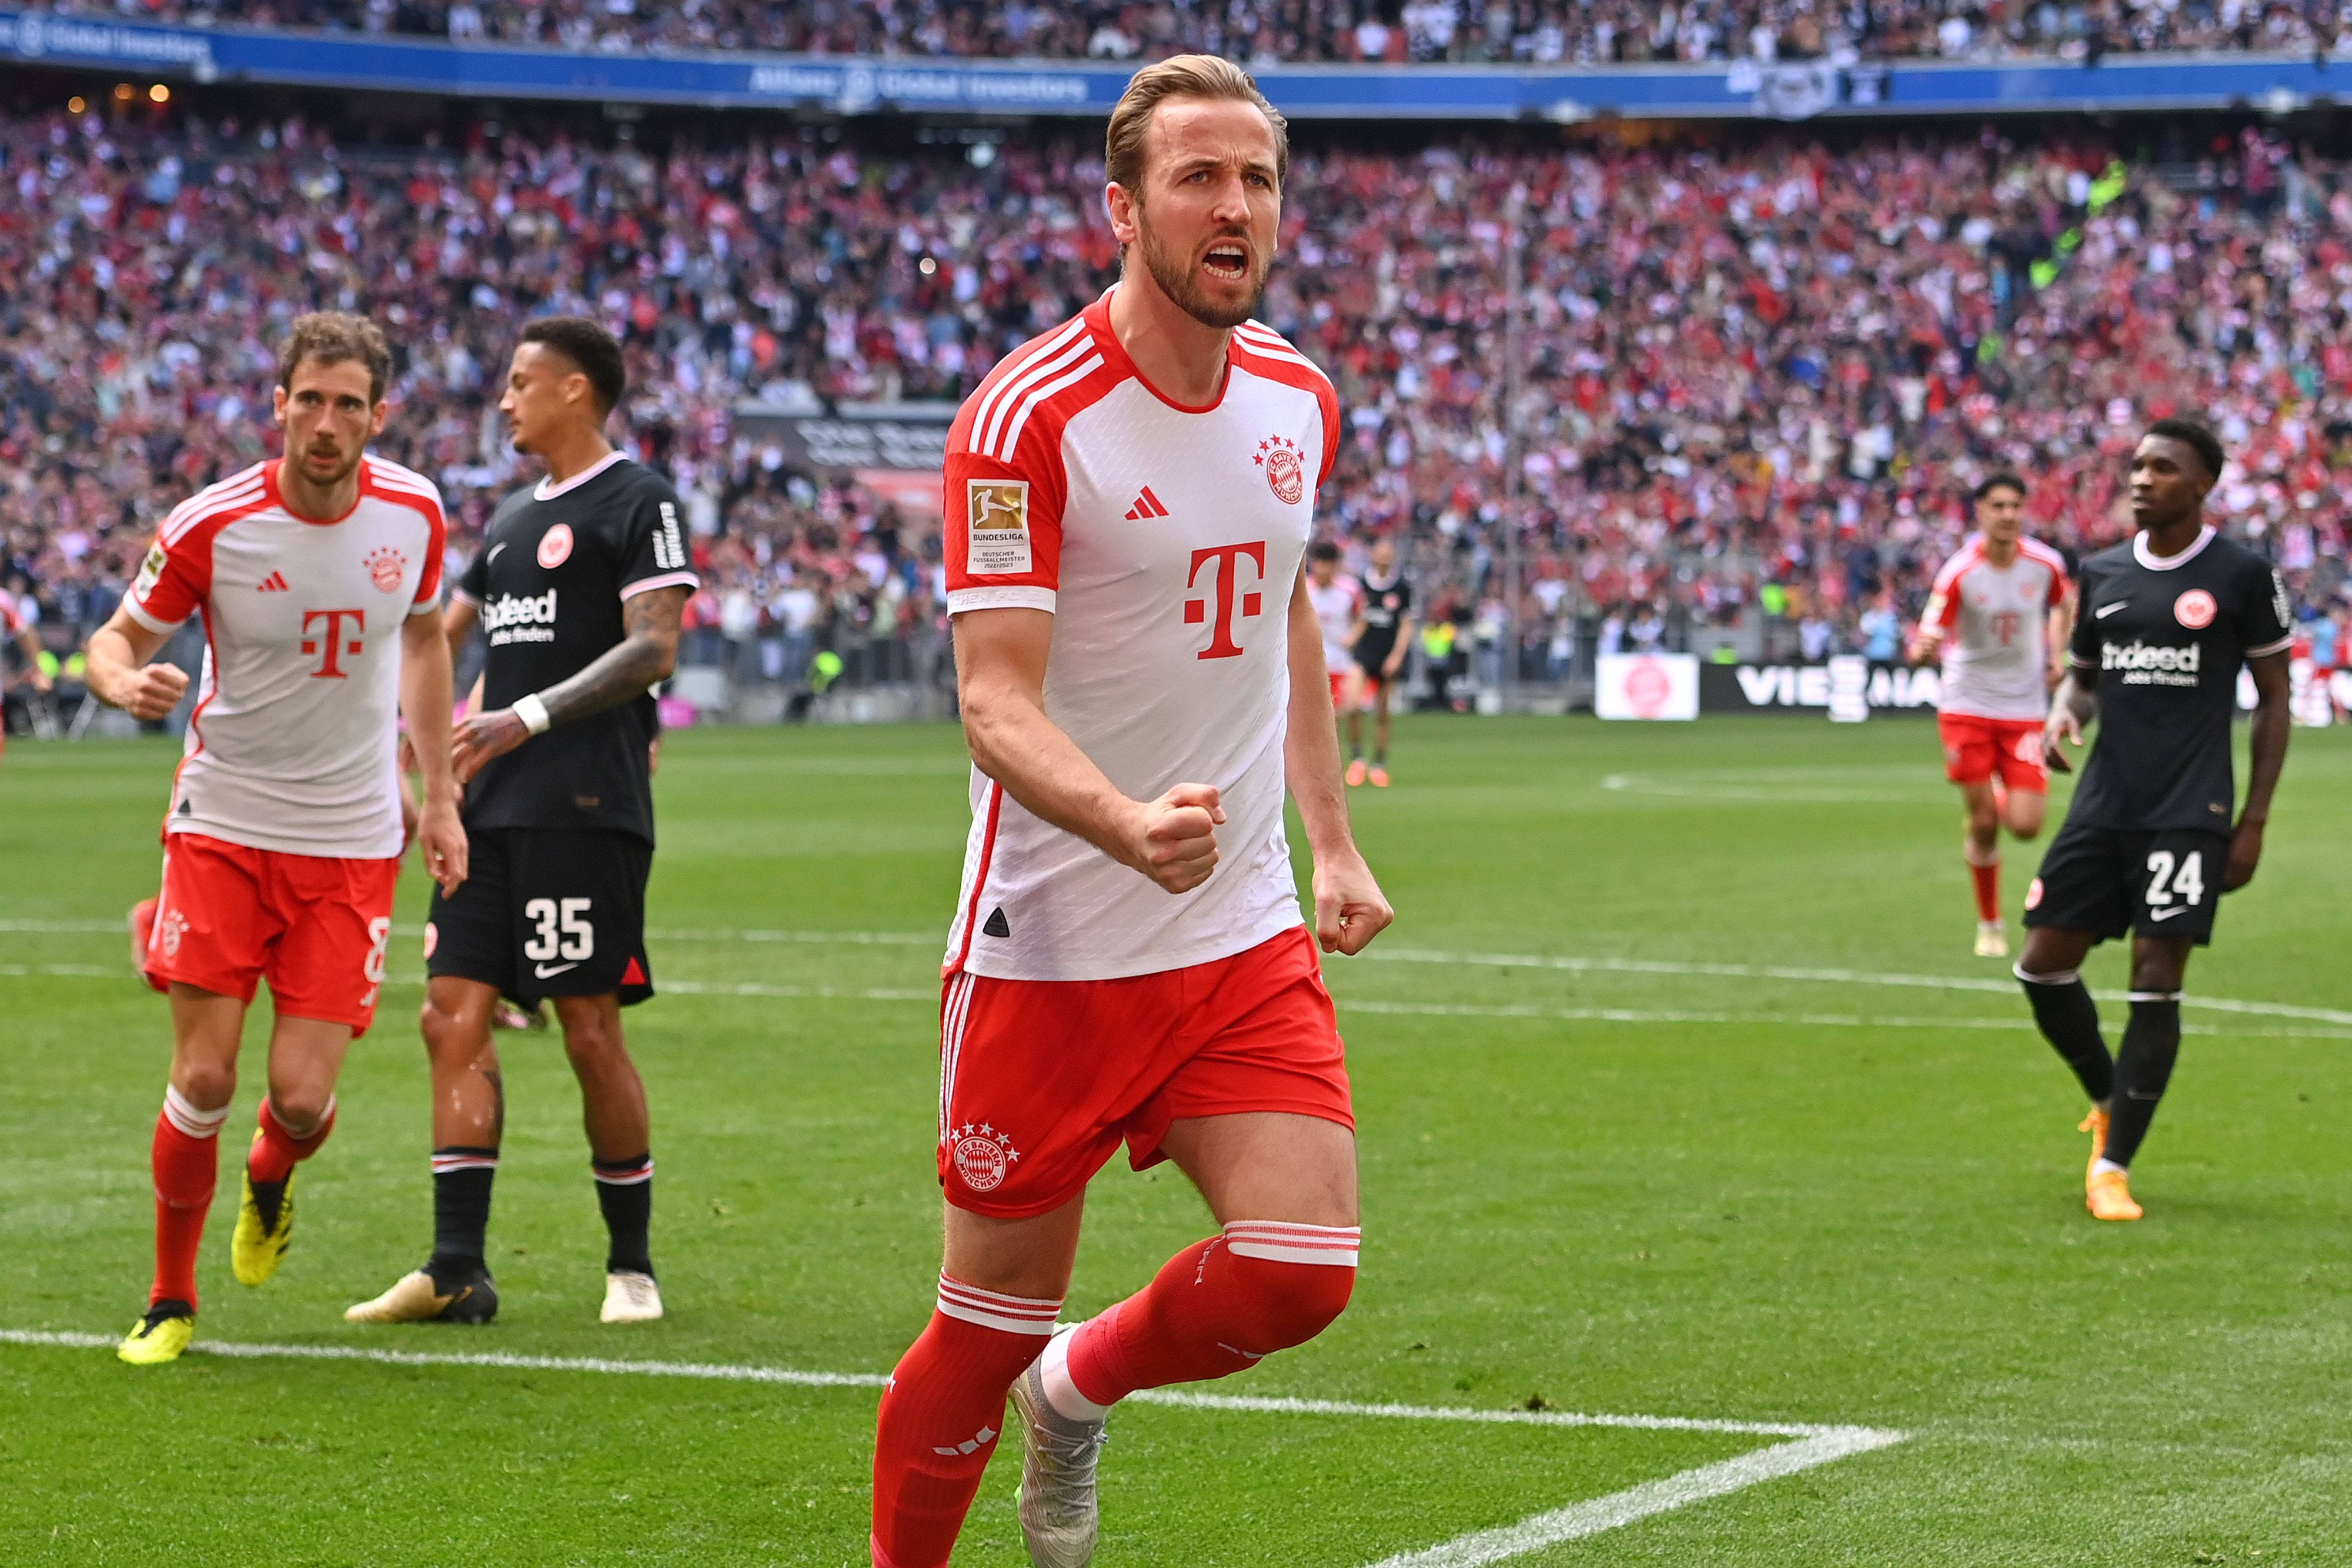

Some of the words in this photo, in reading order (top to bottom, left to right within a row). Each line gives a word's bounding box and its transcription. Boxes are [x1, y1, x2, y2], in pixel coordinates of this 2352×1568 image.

[1273, 453, 1299, 473] BAYERN
[1184, 540, 1265, 660] T
[301, 609, 365, 678] T
[2145, 850, 2205, 906] 24
[363, 917, 390, 983] 8
[524, 897, 594, 961] 35
[960, 1144, 970, 1156] FC
[970, 1141, 1002, 1167] BAYERN
